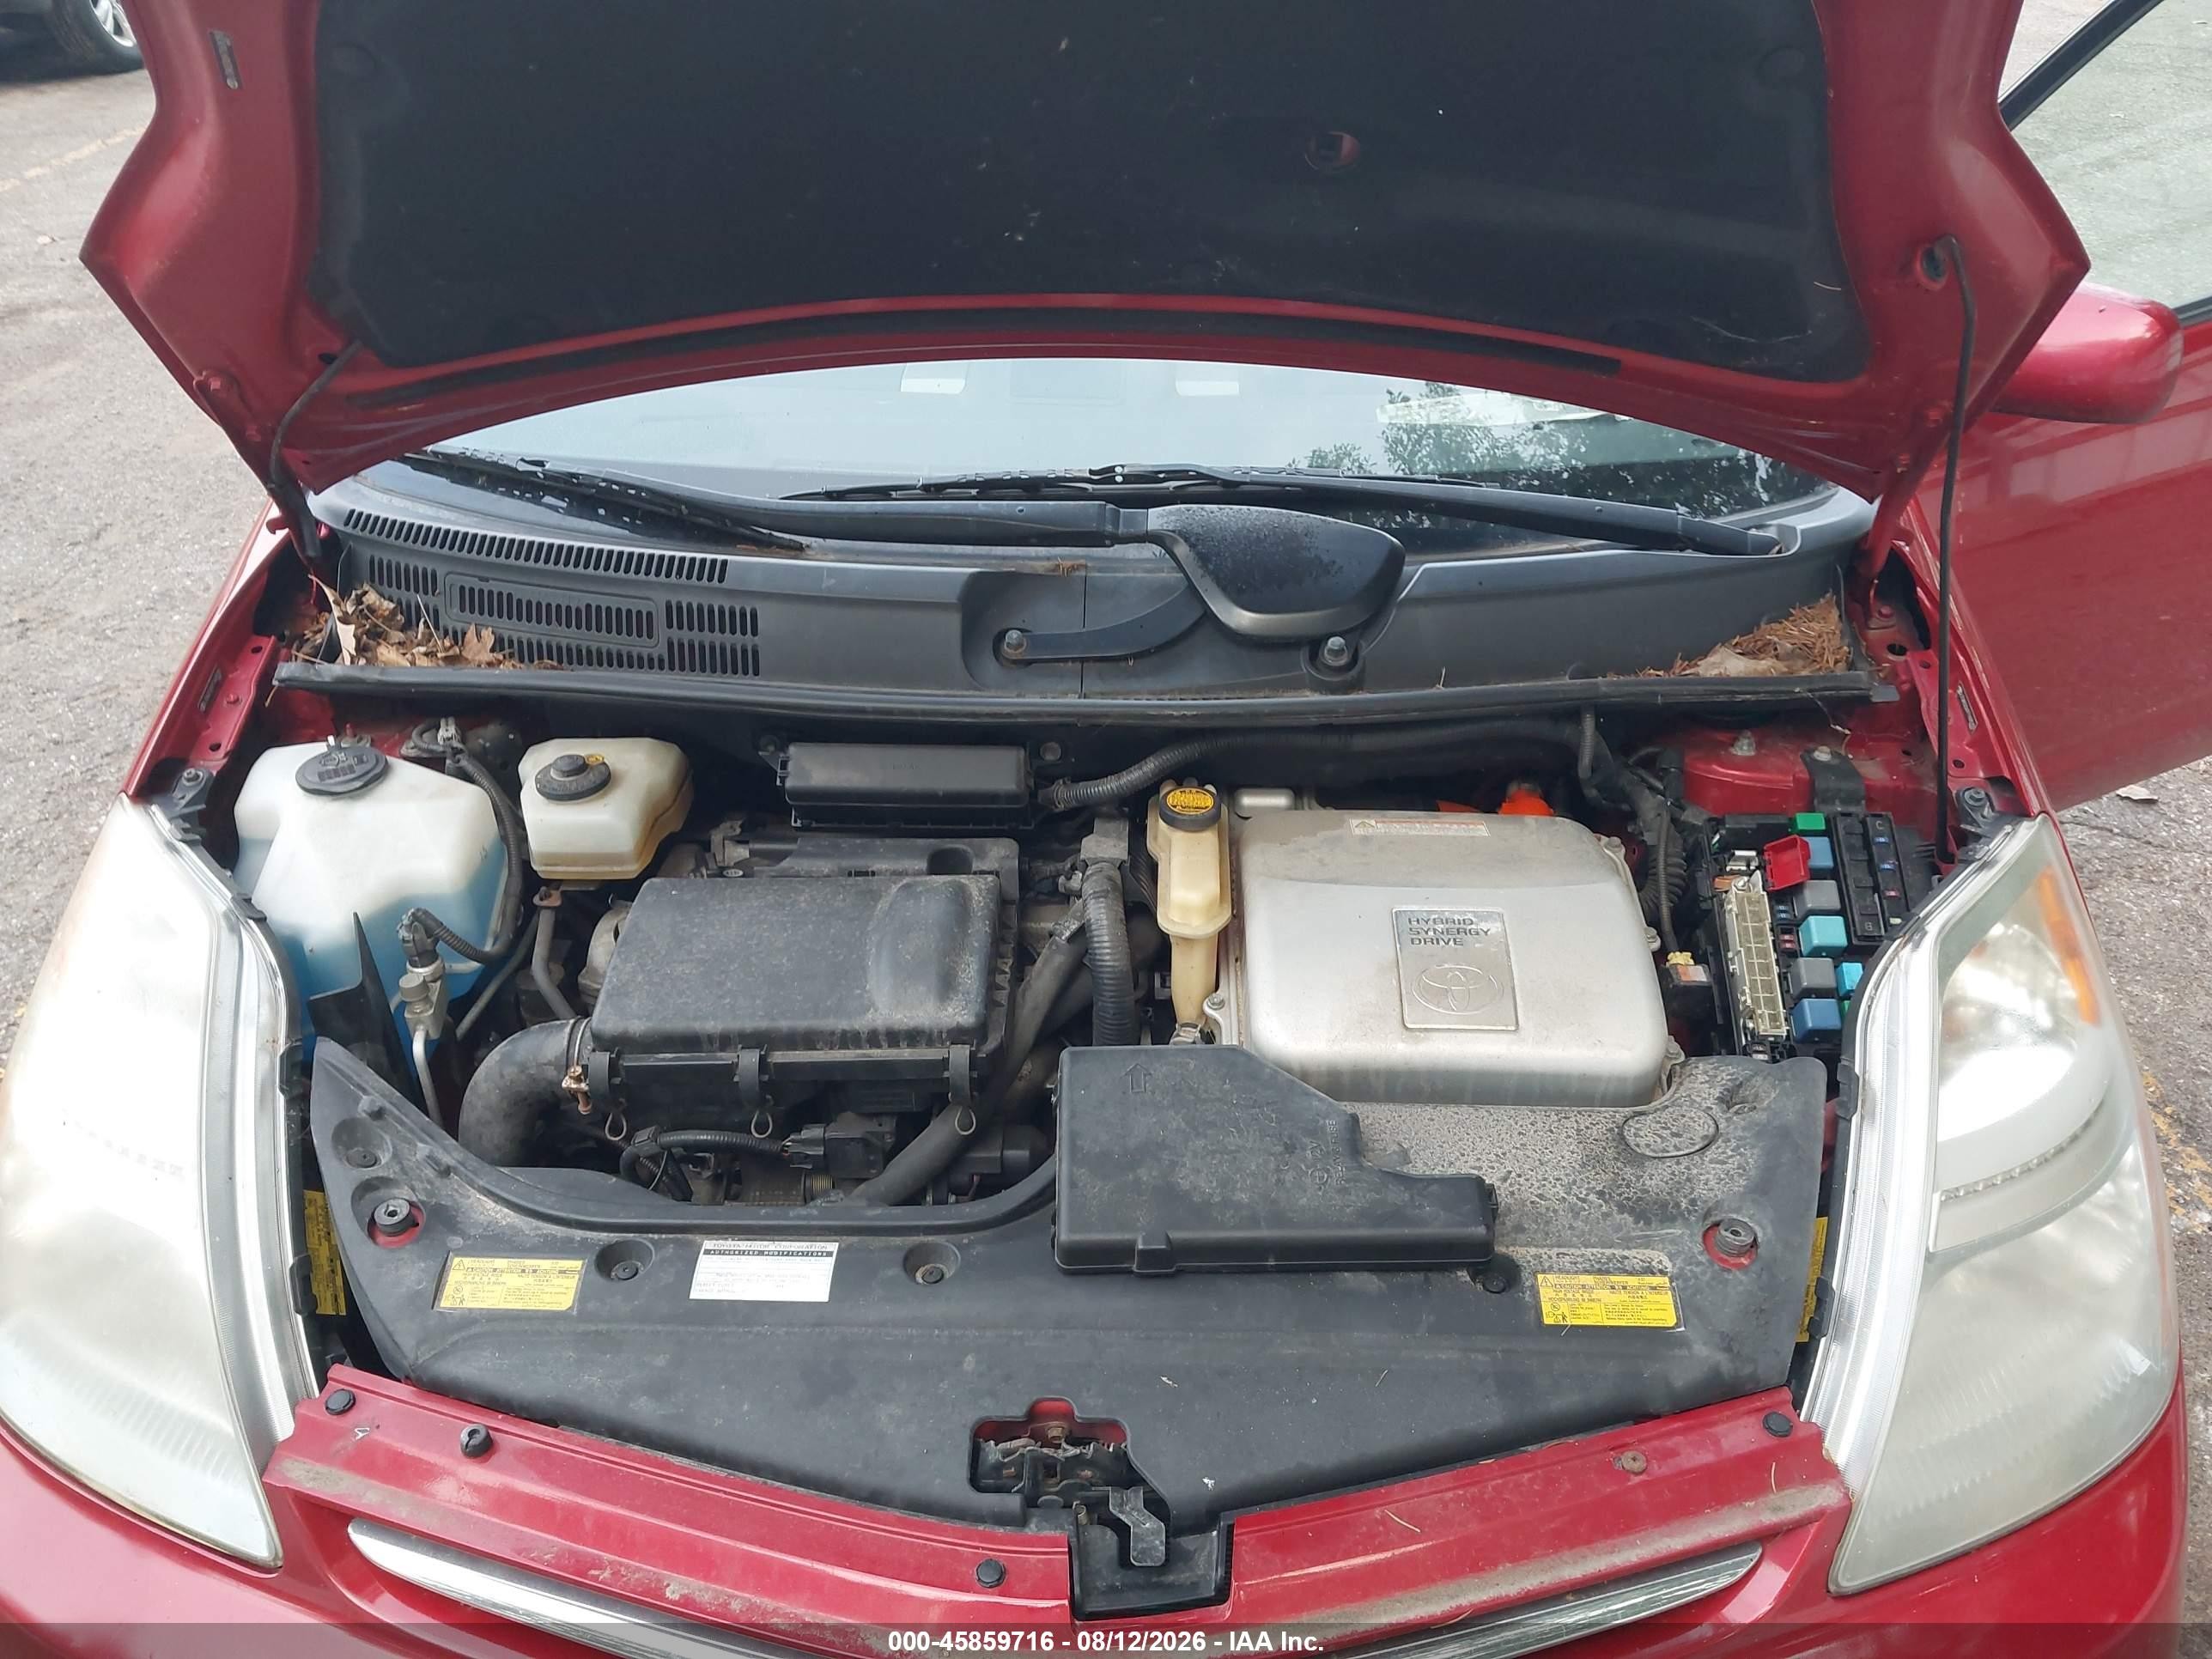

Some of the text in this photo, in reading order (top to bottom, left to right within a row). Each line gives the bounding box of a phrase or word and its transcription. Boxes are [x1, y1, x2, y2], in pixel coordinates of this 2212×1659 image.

[1875, 820, 1885, 830] C
[1408, 917, 1474, 926] HYBRID
[1408, 927, 1491, 936] SYNERGY
[1410, 937, 1464, 946] DRIVE
[1328, 1119, 1340, 1145] FUSE
